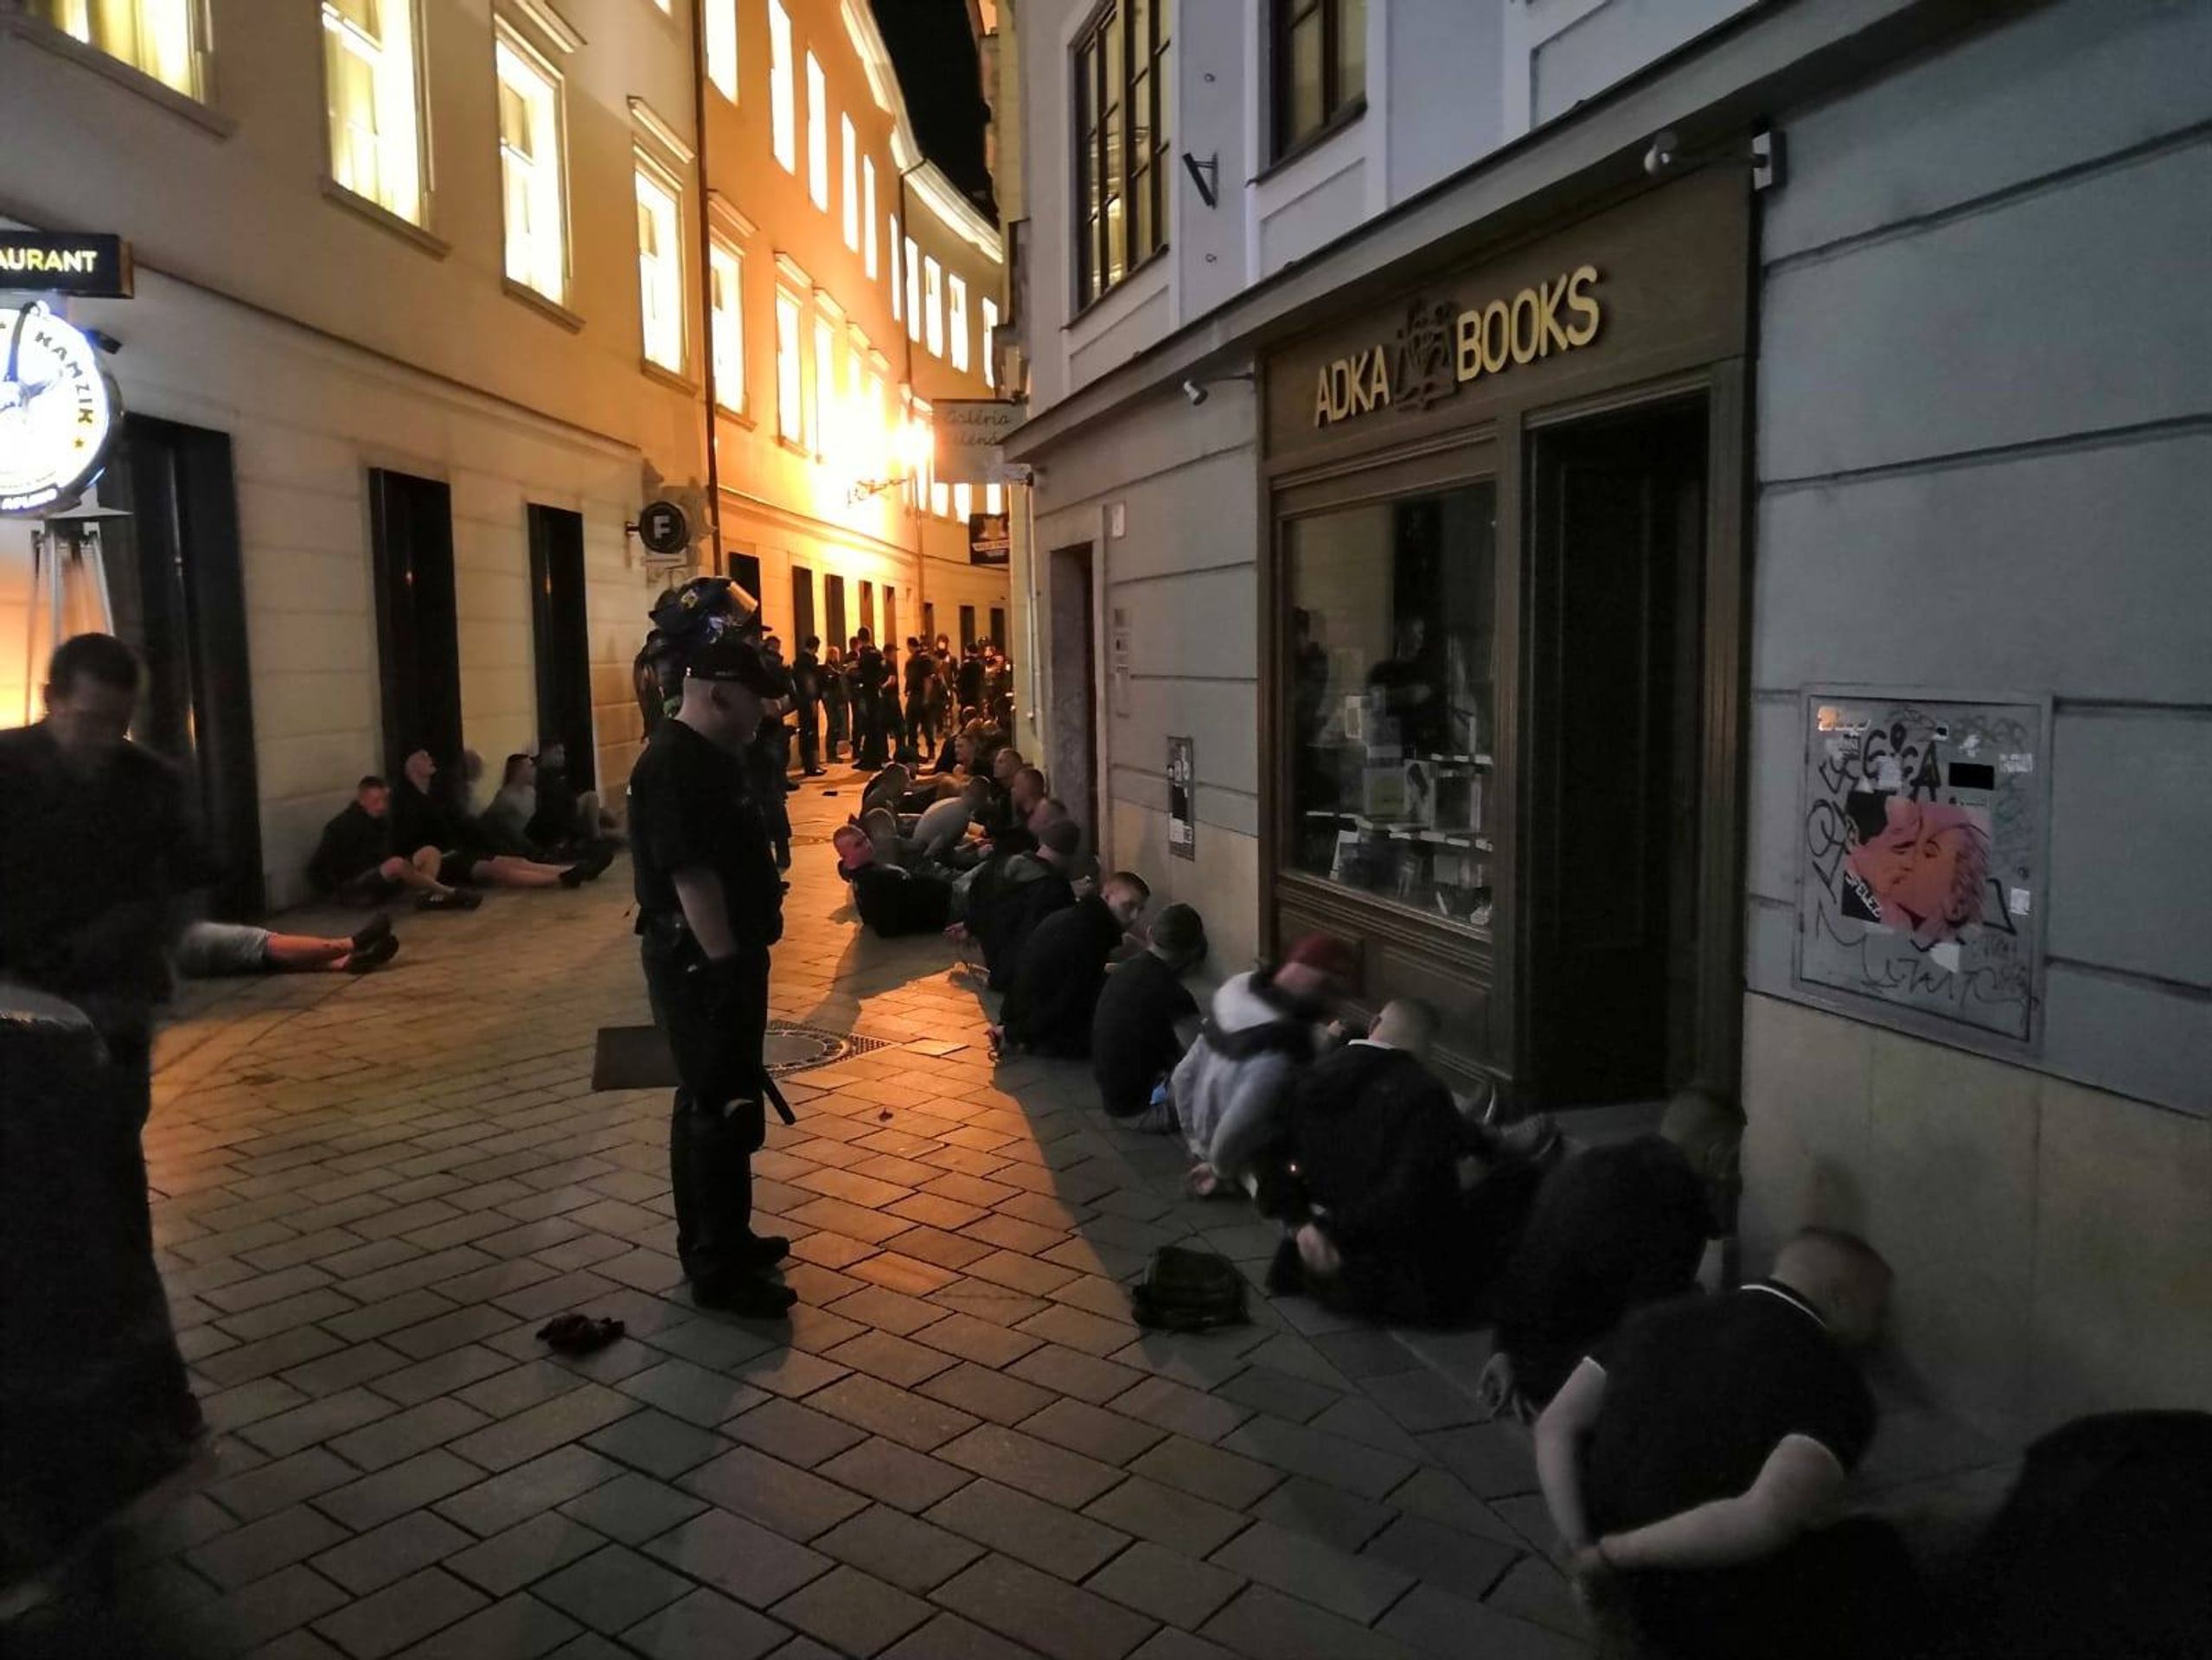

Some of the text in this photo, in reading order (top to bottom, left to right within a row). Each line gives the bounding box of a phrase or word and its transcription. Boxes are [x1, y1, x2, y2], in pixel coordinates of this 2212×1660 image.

[1314, 265, 1600, 427] ADKA BOOKS
[653, 515, 670, 540] F
